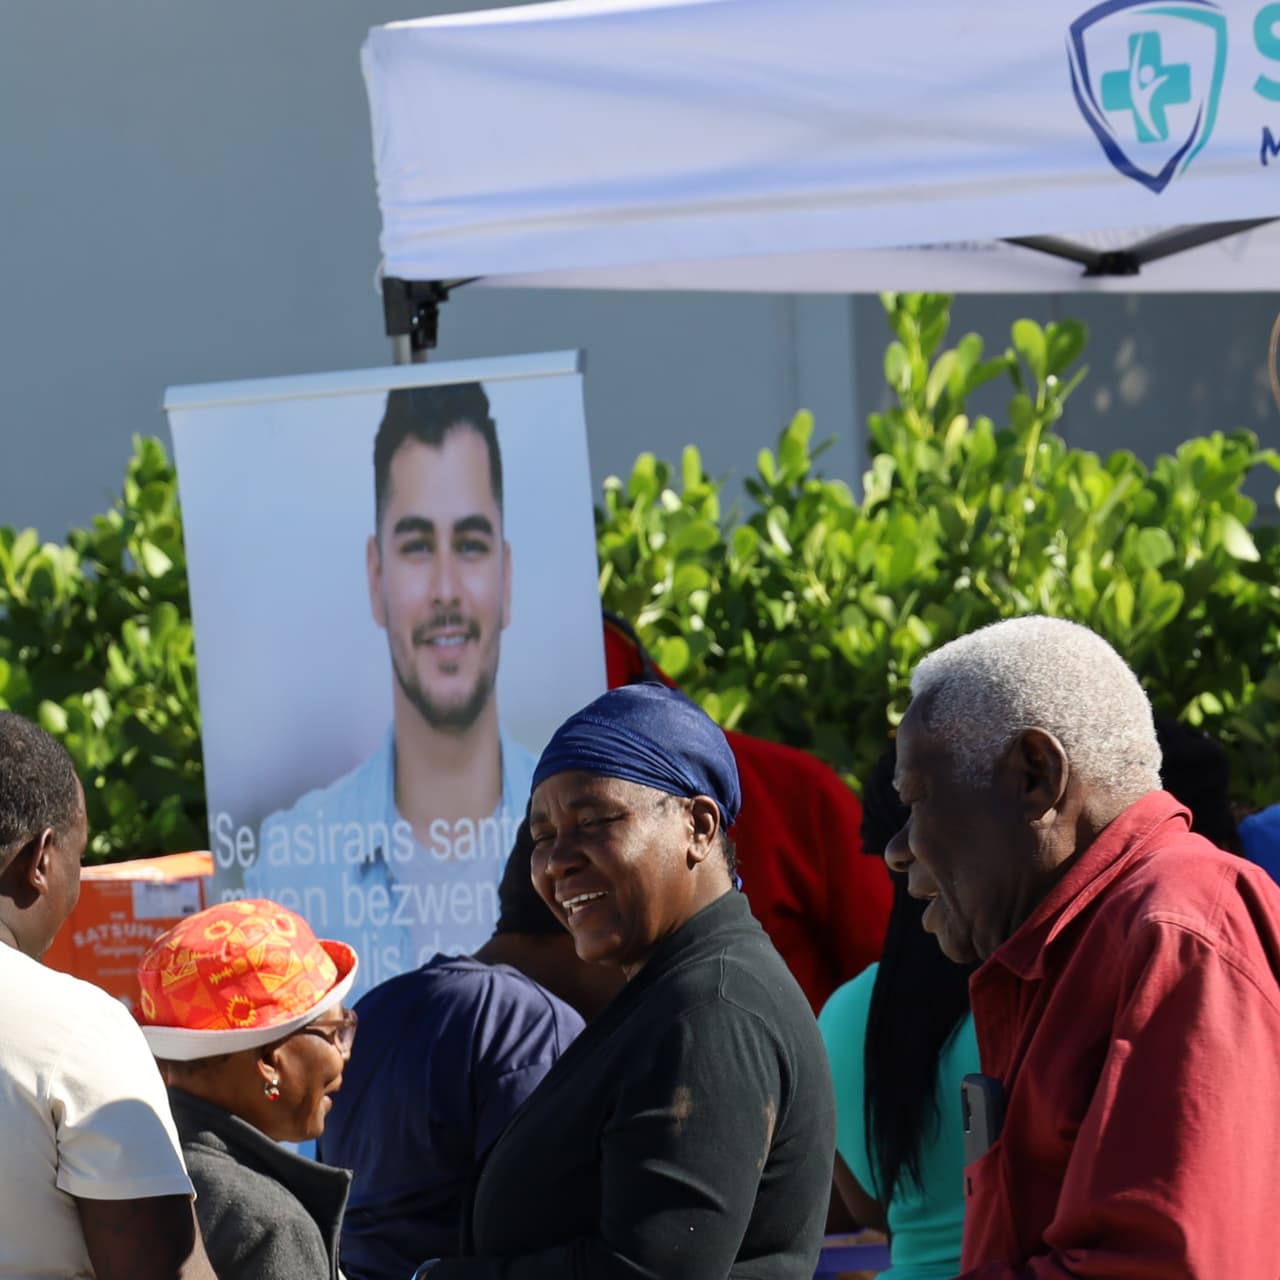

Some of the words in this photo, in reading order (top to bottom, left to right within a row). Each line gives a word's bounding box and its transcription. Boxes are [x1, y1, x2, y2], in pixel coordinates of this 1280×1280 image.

[269, 810, 414, 866] asirans
[342, 871, 498, 929] bezwen
[362, 930, 402, 985] lis
